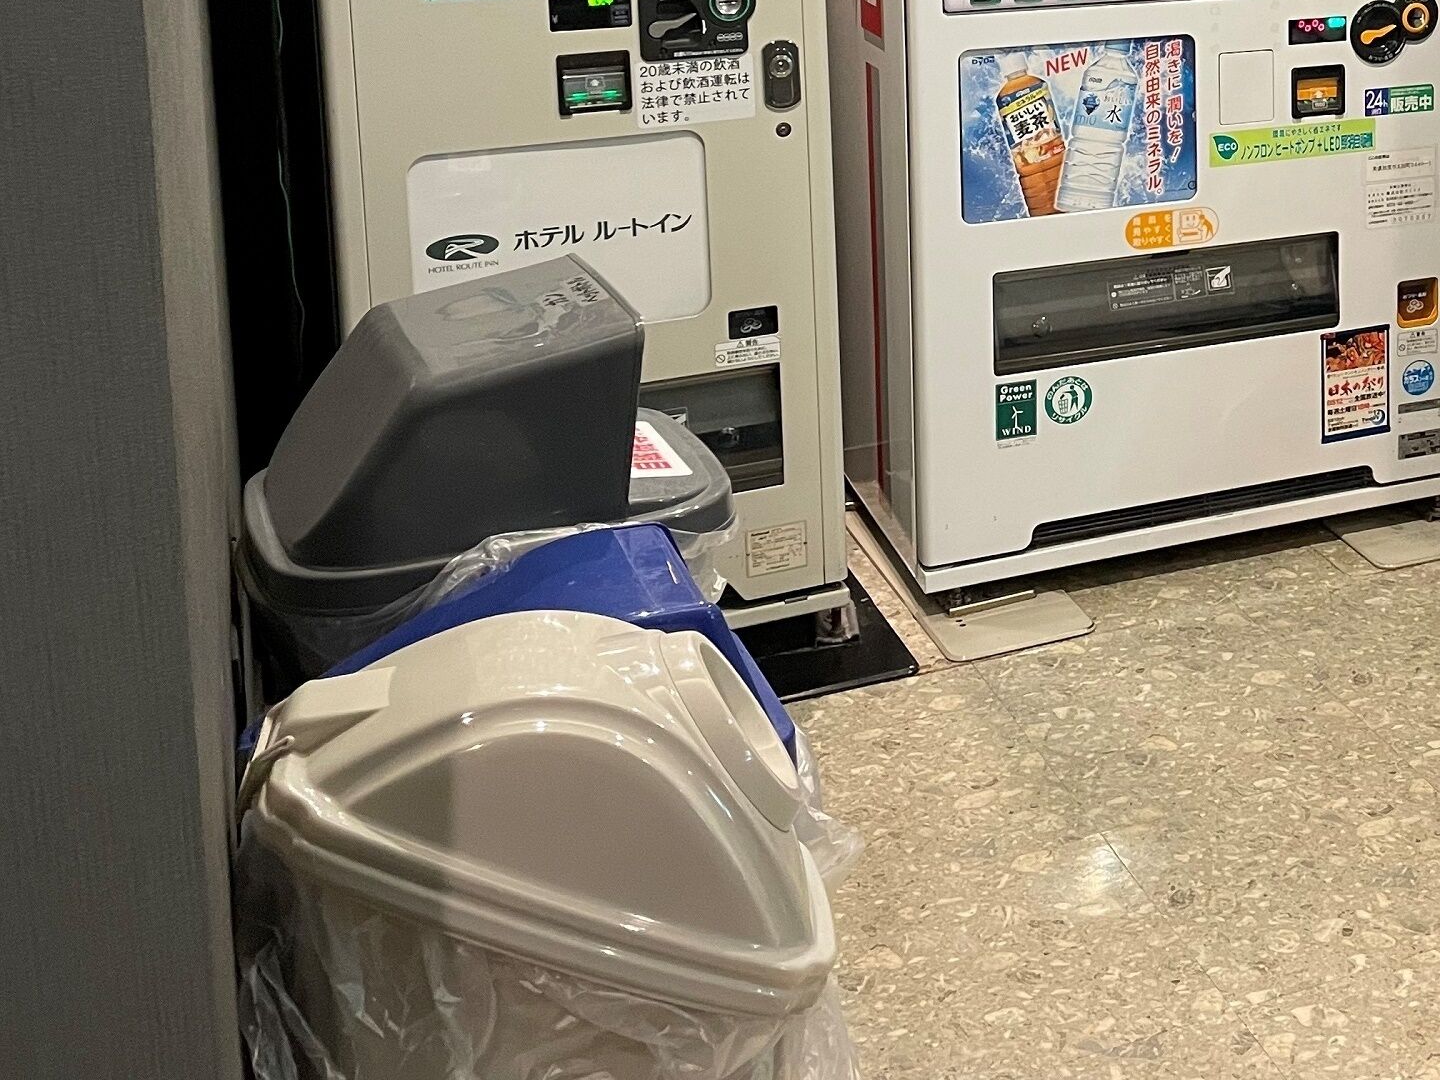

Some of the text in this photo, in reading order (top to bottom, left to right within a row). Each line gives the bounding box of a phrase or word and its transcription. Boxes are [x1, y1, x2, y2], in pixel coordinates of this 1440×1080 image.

[639, 57, 740, 78] 20歳未満の飲酒
[971, 56, 995, 66] DyDo
[1046, 49, 1089, 76] NEW
[1166, 41, 1181, 91] 渇きに
[640, 72, 750, 94] および飲酒運転は
[641, 87, 750, 110] 法律で禁止されて
[1390, 95, 1433, 113] 販売中
[642, 110, 690, 125] います。
[1009, 103, 1045, 123] おいしい
[1105, 105, 1122, 124] 水
[1145, 44, 1164, 195] 自然由来のミネラル。
[1014, 111, 1050, 139] 麦茶
[1217, 142, 1237, 152] ECO
[513, 213, 692, 251] ホテル ルートイン
[1132, 235, 1171, 247] 取りやすく
[428, 260, 500, 274] HOTEL ROUTE INN
[1000, 384, 1032, 395] Green
[1000, 392, 1033, 403] Power
[1002, 425, 1032, 436] WIND
